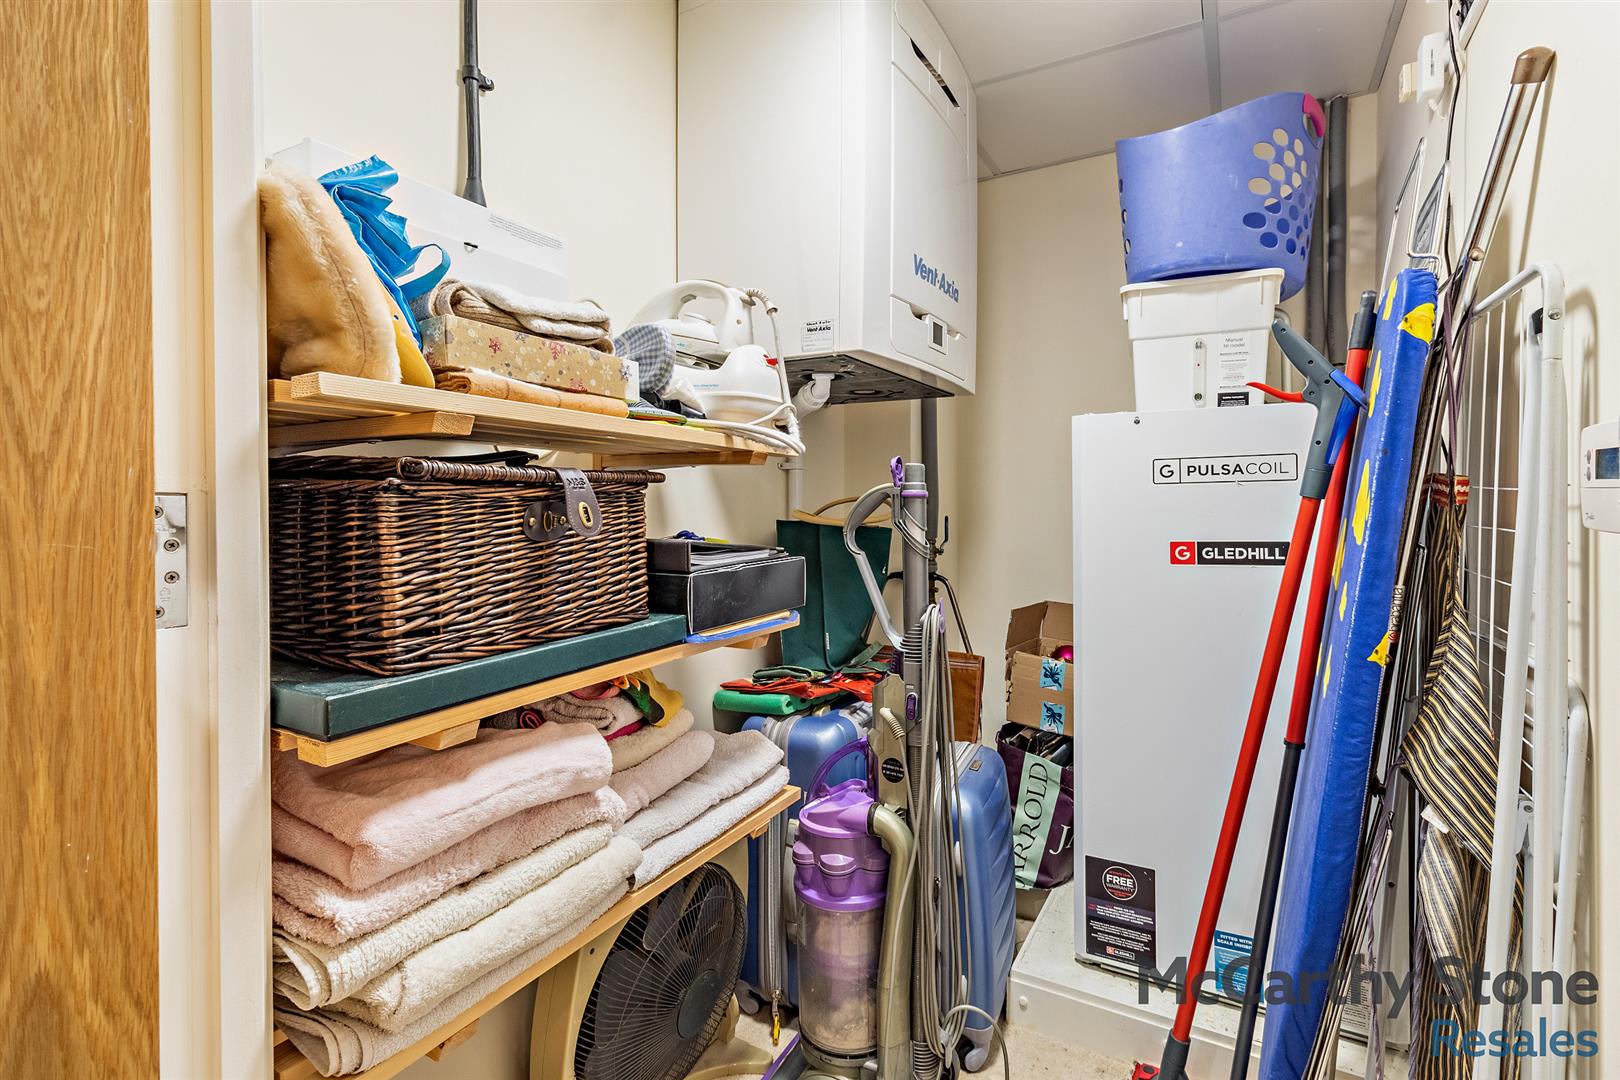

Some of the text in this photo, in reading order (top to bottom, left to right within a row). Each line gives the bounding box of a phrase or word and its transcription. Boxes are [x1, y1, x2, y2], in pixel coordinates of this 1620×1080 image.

[1187, 462, 1289, 477] PULSACOIL
[1201, 547, 1286, 560] GLEDHILL
[1106, 874, 1134, 888] FREE
[1216, 938, 1233, 946] SCALE
